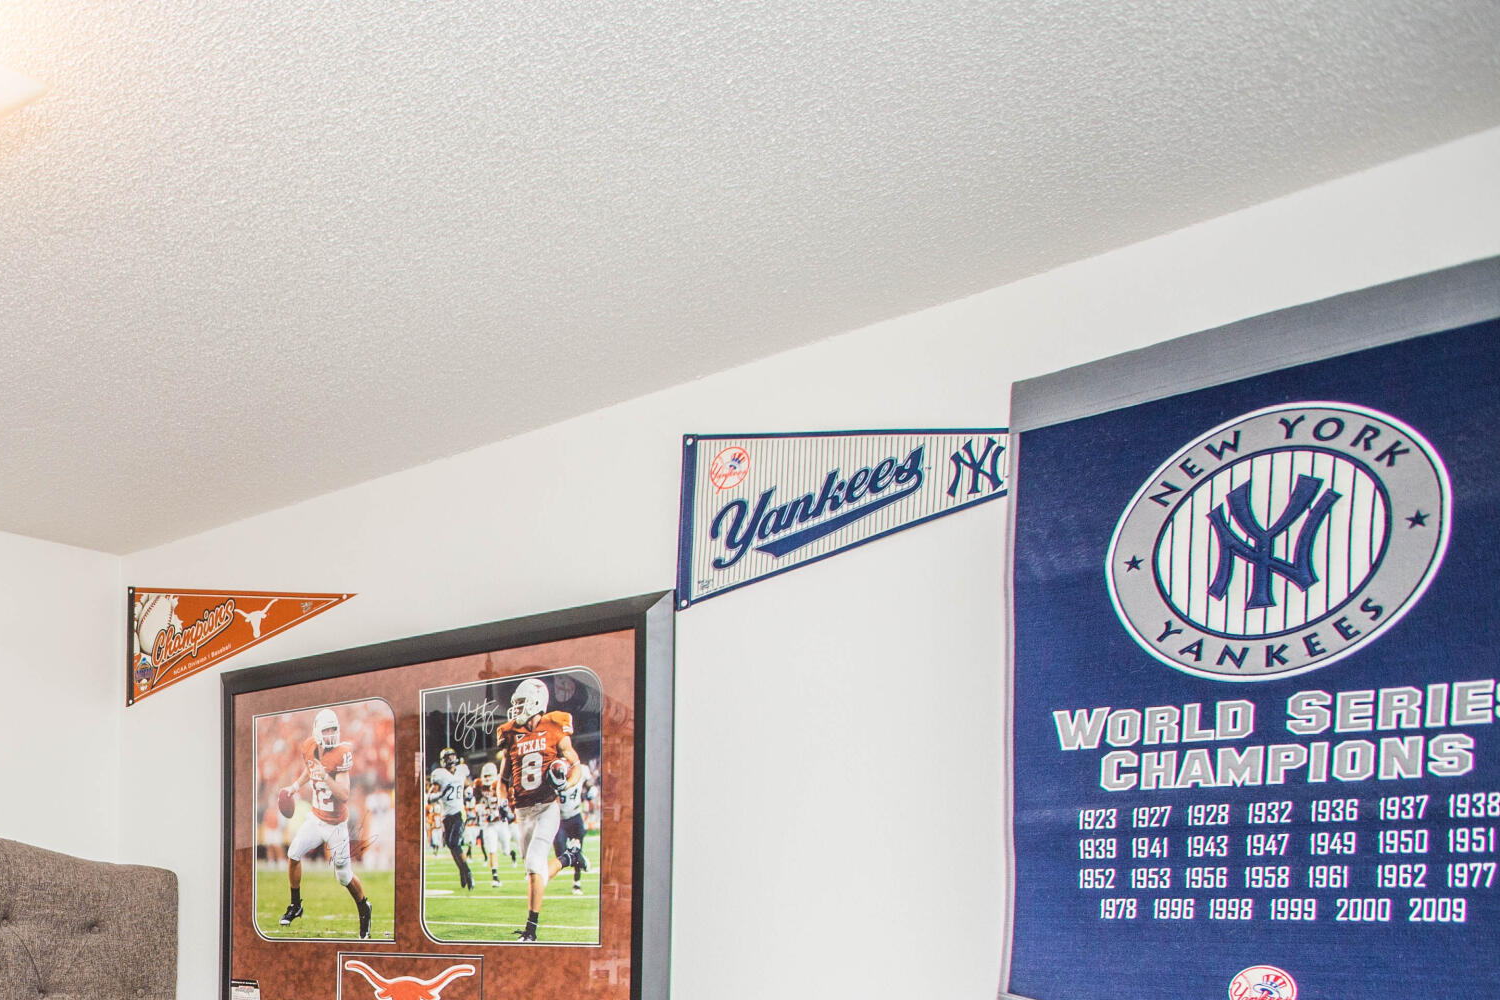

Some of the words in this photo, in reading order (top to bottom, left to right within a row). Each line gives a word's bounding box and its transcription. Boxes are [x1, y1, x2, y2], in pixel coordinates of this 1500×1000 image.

[1148, 430, 1240, 508] NEW
[1278, 415, 1411, 468] YORK
[710, 444, 925, 570] Yankees
[1206, 474, 1342, 610] NY
[152, 597, 235, 668] Champions
[1156, 597, 1384, 670] YANKEES
[1053, 699, 1255, 750] WORLD
[1286, 679, 1500, 735] SERIE
[517, 738, 546, 755] TEXAS
[520, 752, 543, 791] 8
[1100, 733, 1475, 791] CHAMPIONS
[1079, 808, 1117, 830] 1923
[1132, 806, 1172, 828] 1927
[1188, 804, 1230, 826] 1928
[1248, 801, 1293, 824] 1932
[1311, 798, 1359, 822] 1936
[1379, 795, 1429, 820] 1937
[1449, 792, 1500, 818] 1938
[1079, 838, 1117, 859] 1939
[1132, 837, 1169, 858] 1941
[1187, 835, 1229, 857] 1943
[1246, 833, 1290, 856] 1947
[1310, 831, 1357, 855] 1949
[1378, 829, 1429, 854] 1950
[1448, 827, 1495, 853] 1951
[1079, 868, 1116, 889] 1952
[1131, 867, 1171, 889] 1953
[1185, 866, 1228, 888] 1956
[1245, 866, 1290, 888] 1958
[1308, 865, 1349, 888] 1961
[1377, 863, 1428, 888] 1962
[1447, 862, 1497, 888] 1977
[1100, 898, 1137, 919] 1978
[1153, 898, 1195, 920] 1996
[1209, 898, 1253, 920] 1998
[1270, 898, 1316, 921] 1999
[1335, 898, 1392, 921] 2000
[1408, 898, 1467, 922] 2009
